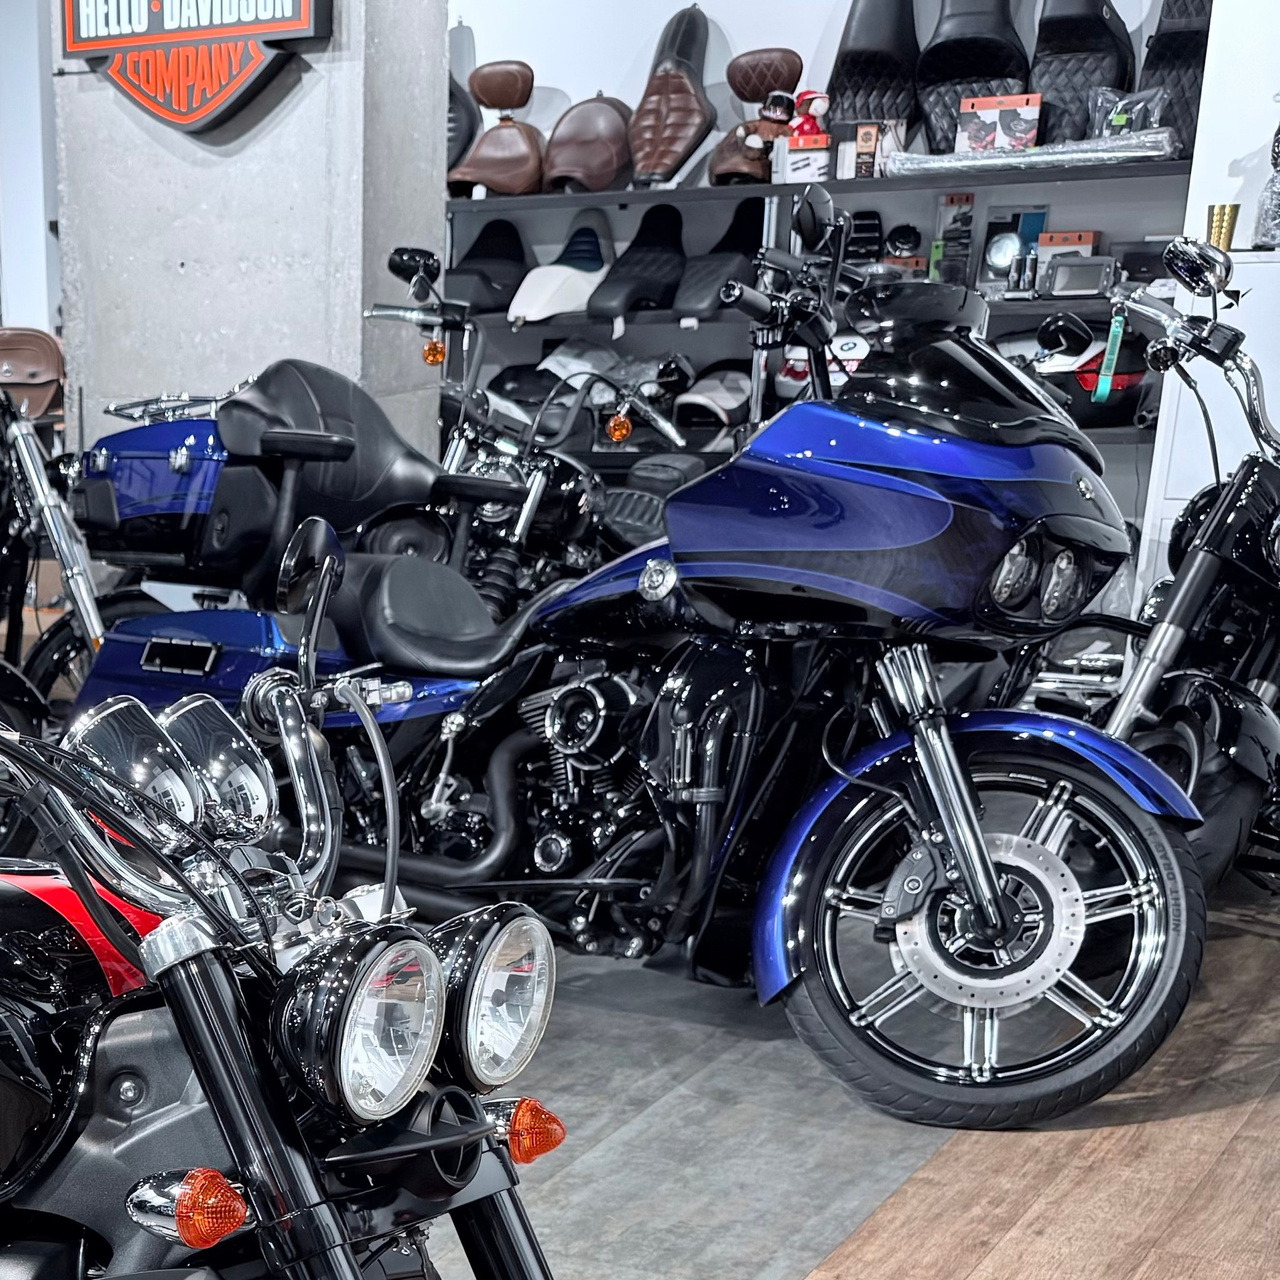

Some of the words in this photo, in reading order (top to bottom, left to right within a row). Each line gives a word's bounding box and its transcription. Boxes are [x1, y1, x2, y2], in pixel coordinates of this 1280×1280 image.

[126, 40, 245, 112] COMPANY
[1144, 826, 1177, 880] DRAGN
[1169, 887, 1182, 933] NIGHT
